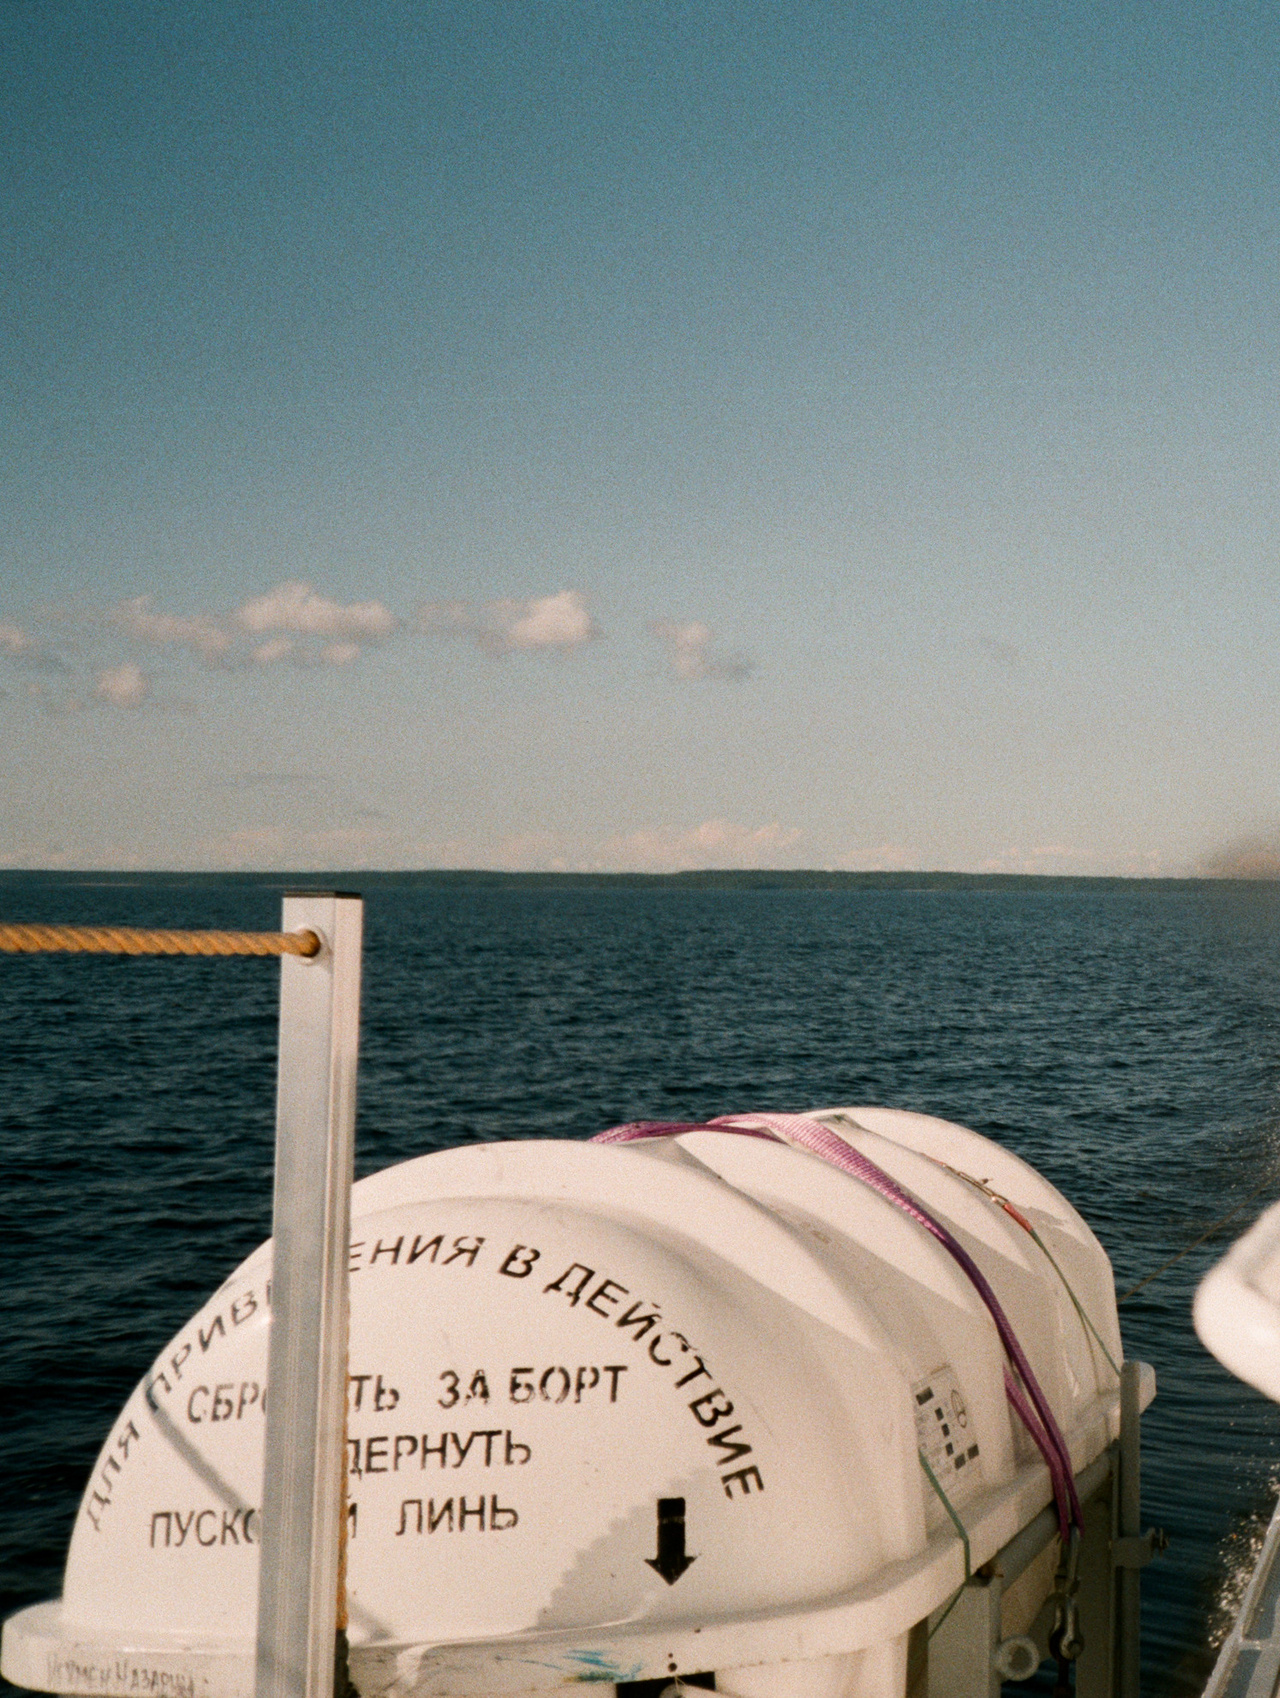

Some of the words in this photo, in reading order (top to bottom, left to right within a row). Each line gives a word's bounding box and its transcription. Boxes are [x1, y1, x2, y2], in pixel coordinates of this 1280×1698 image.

[85, 1419, 141, 1533] ДЛЯ
[145, 1235, 486, 1411] ПРИВЕНИЯ
[497, 1243, 541, 1279] В
[542, 1262, 765, 1501] ДЕЙСТВИЕ
[187, 1375, 400, 1424] СБРТЬ
[438, 1369, 490, 1409] ЗА
[509, 1365, 628, 1404] БОРТ
[150, 1494, 358, 1548] ПУСКО
[395, 1494, 519, 1537] ЛИНЬ
